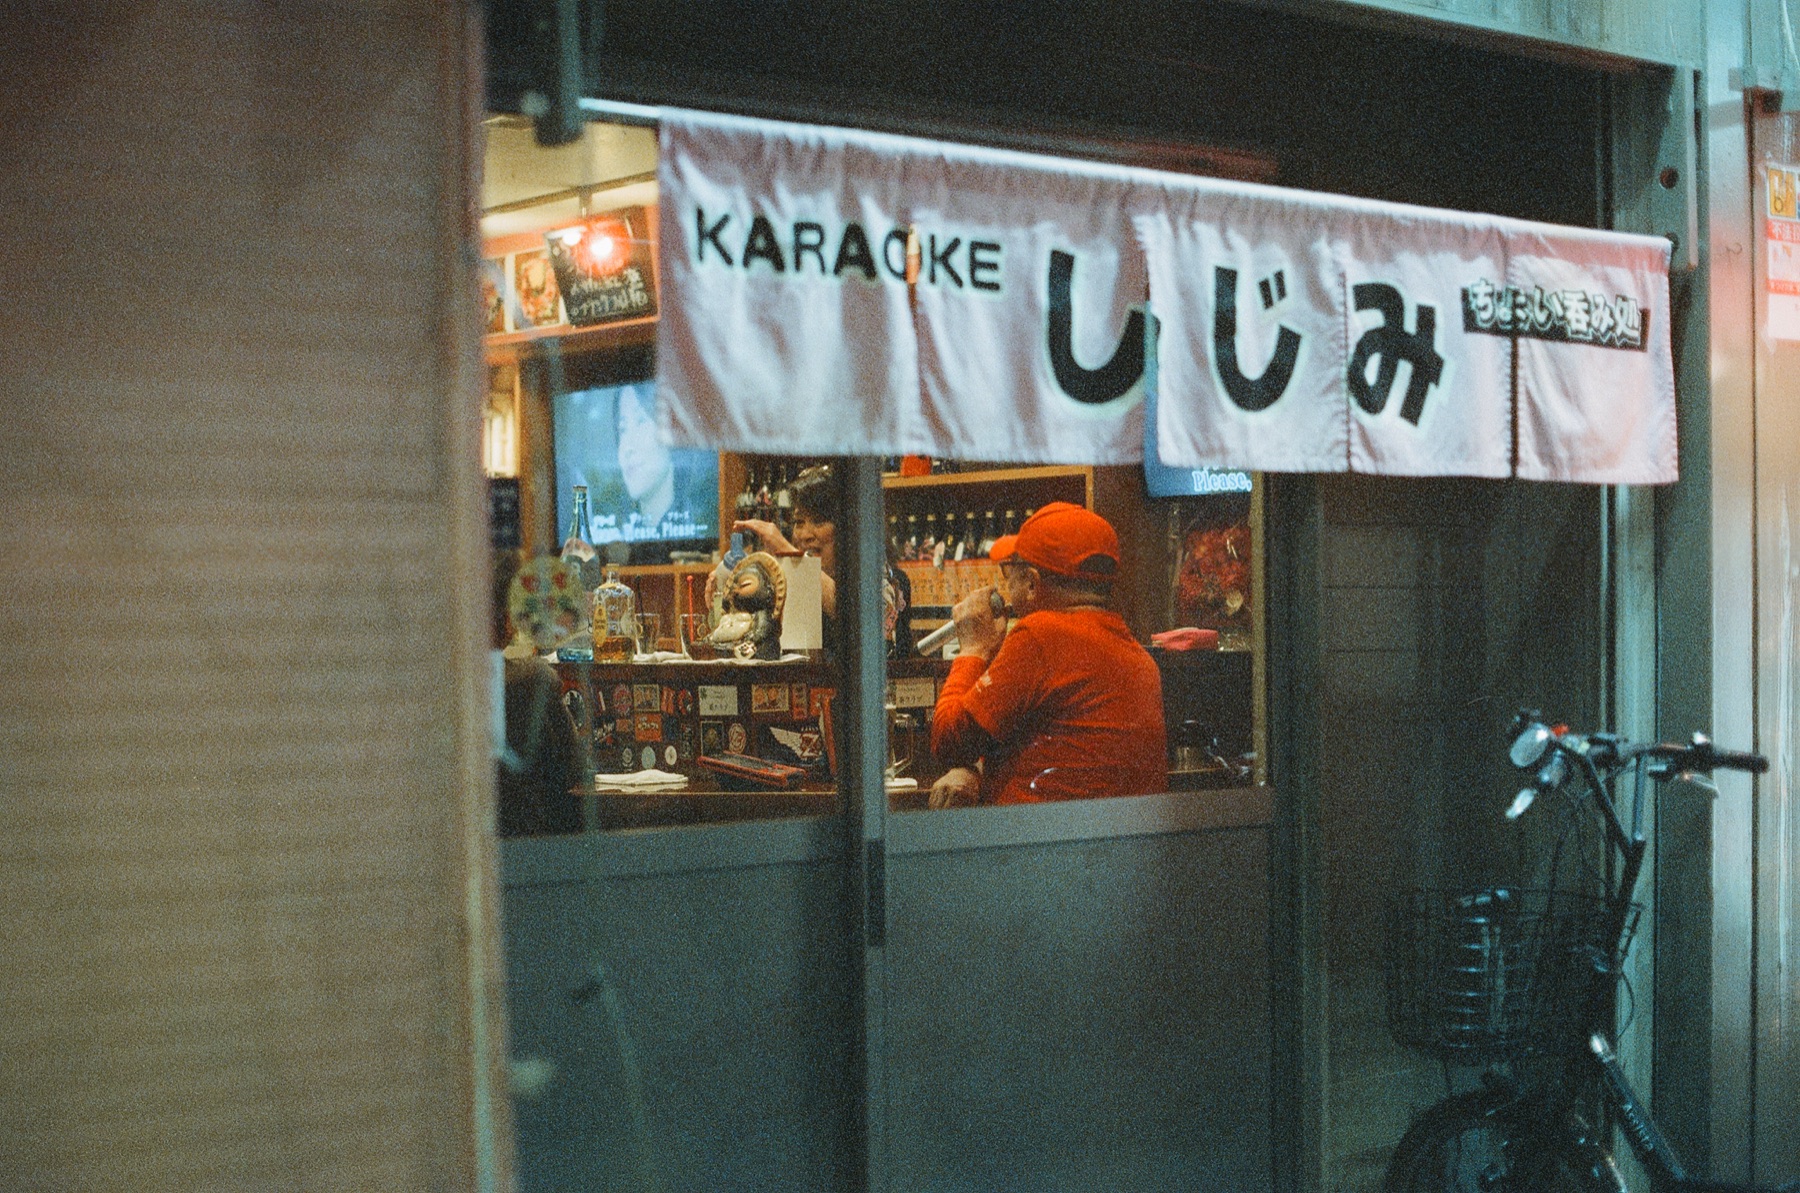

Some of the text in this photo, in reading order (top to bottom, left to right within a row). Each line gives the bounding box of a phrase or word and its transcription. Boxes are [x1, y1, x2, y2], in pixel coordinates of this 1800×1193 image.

[696, 206, 1001, 291] KARAOKE
[1048, 248, 1445, 427] しじみ
[1192, 470, 1253, 492] Please,
